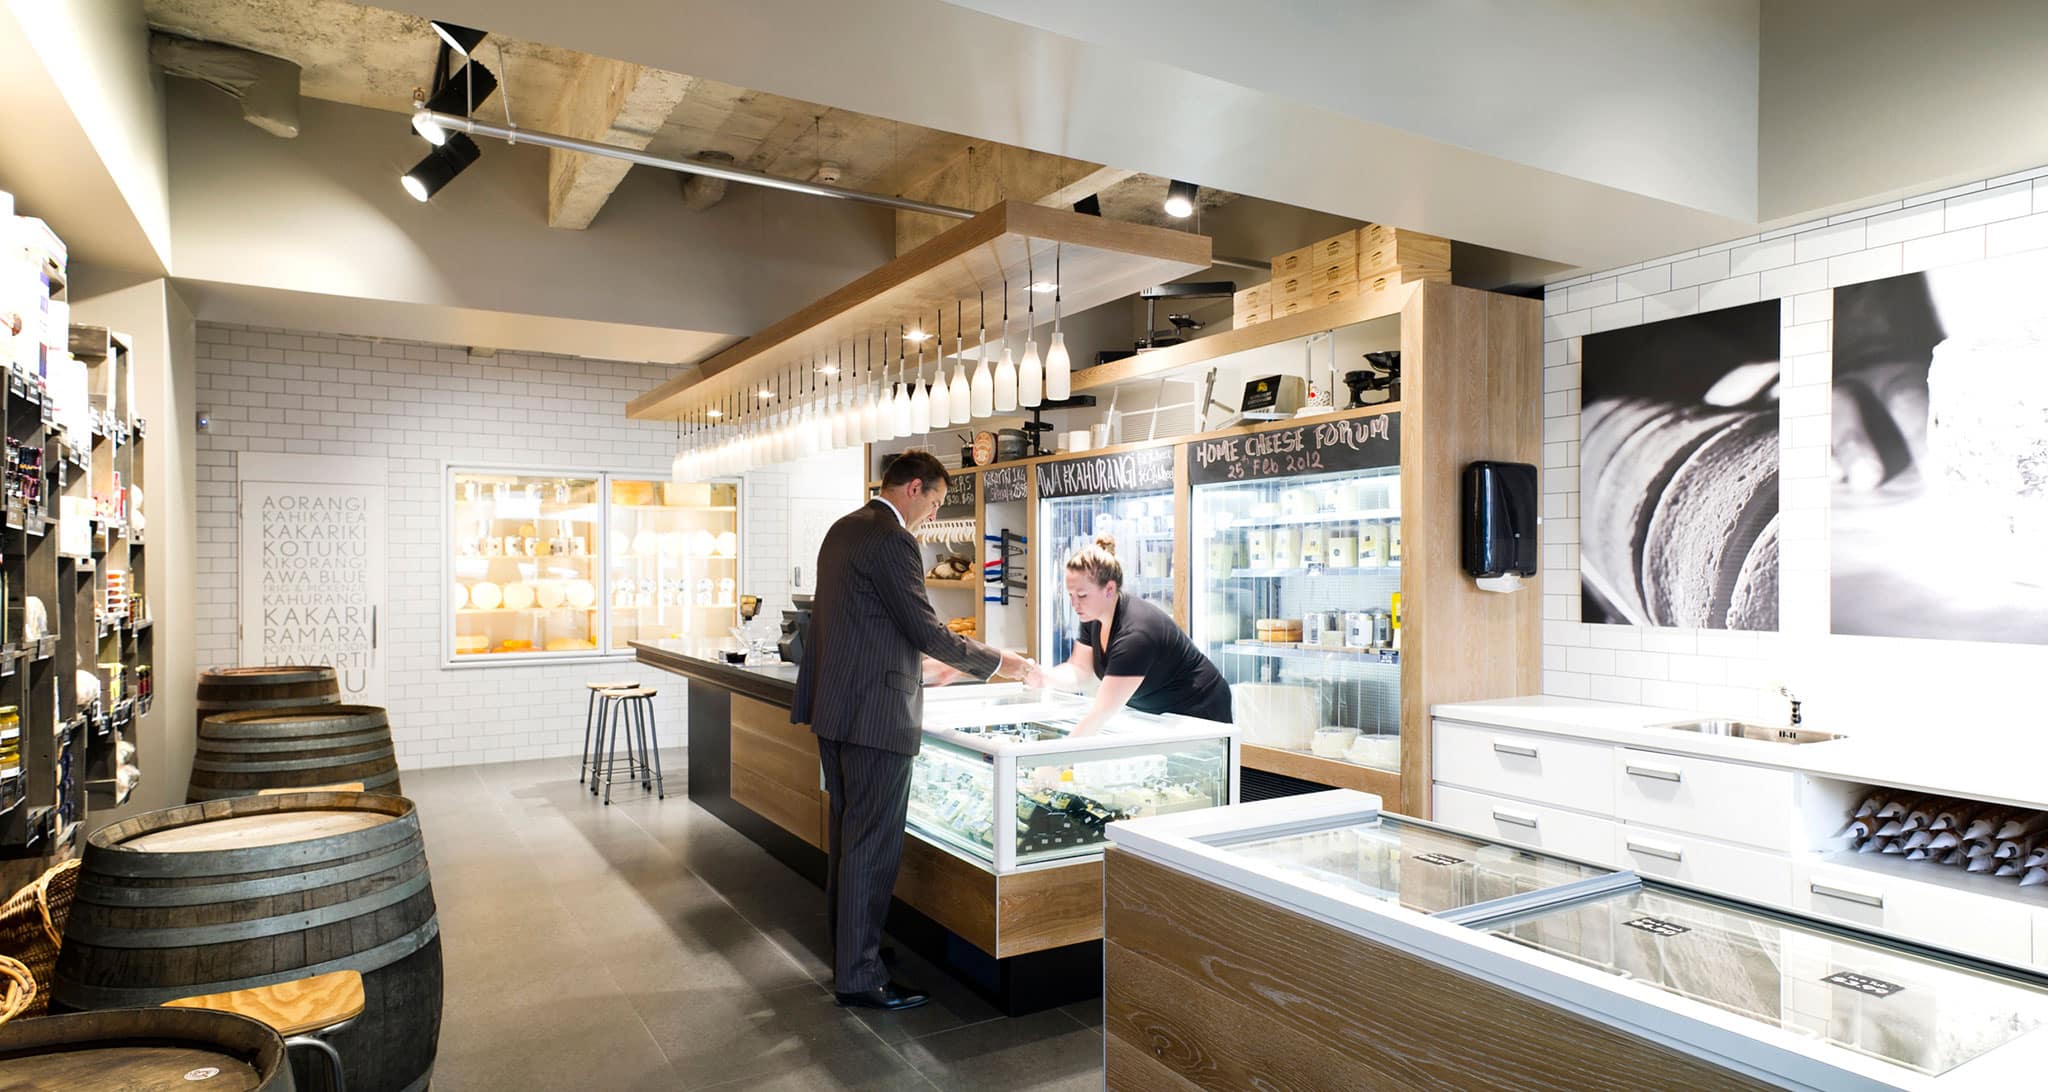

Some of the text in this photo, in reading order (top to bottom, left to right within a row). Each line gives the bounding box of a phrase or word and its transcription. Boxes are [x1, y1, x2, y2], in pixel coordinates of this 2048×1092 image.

[1197, 439, 1240, 469] HOME
[1244, 427, 1305, 456] CHEESE
[1313, 414, 1390, 451] FORUM
[1286, 450, 1325, 472] 2012
[1037, 463, 1063, 497] AWA
[262, 496, 367, 511] AORANGI
[262, 511, 367, 524] KAHIKATEA
[263, 524, 367, 540] KAKARIKI
[263, 540, 367, 557] KOTUKU
[263, 557, 368, 569] KIKORANGI
[263, 570, 368, 584] AWA BLUE
[263, 593, 367, 606] KAHURANGI
[264, 606, 367, 626] KAKARI
[264, 626, 367, 645] RAMARA
[264, 652, 367, 668] HAVARTI
